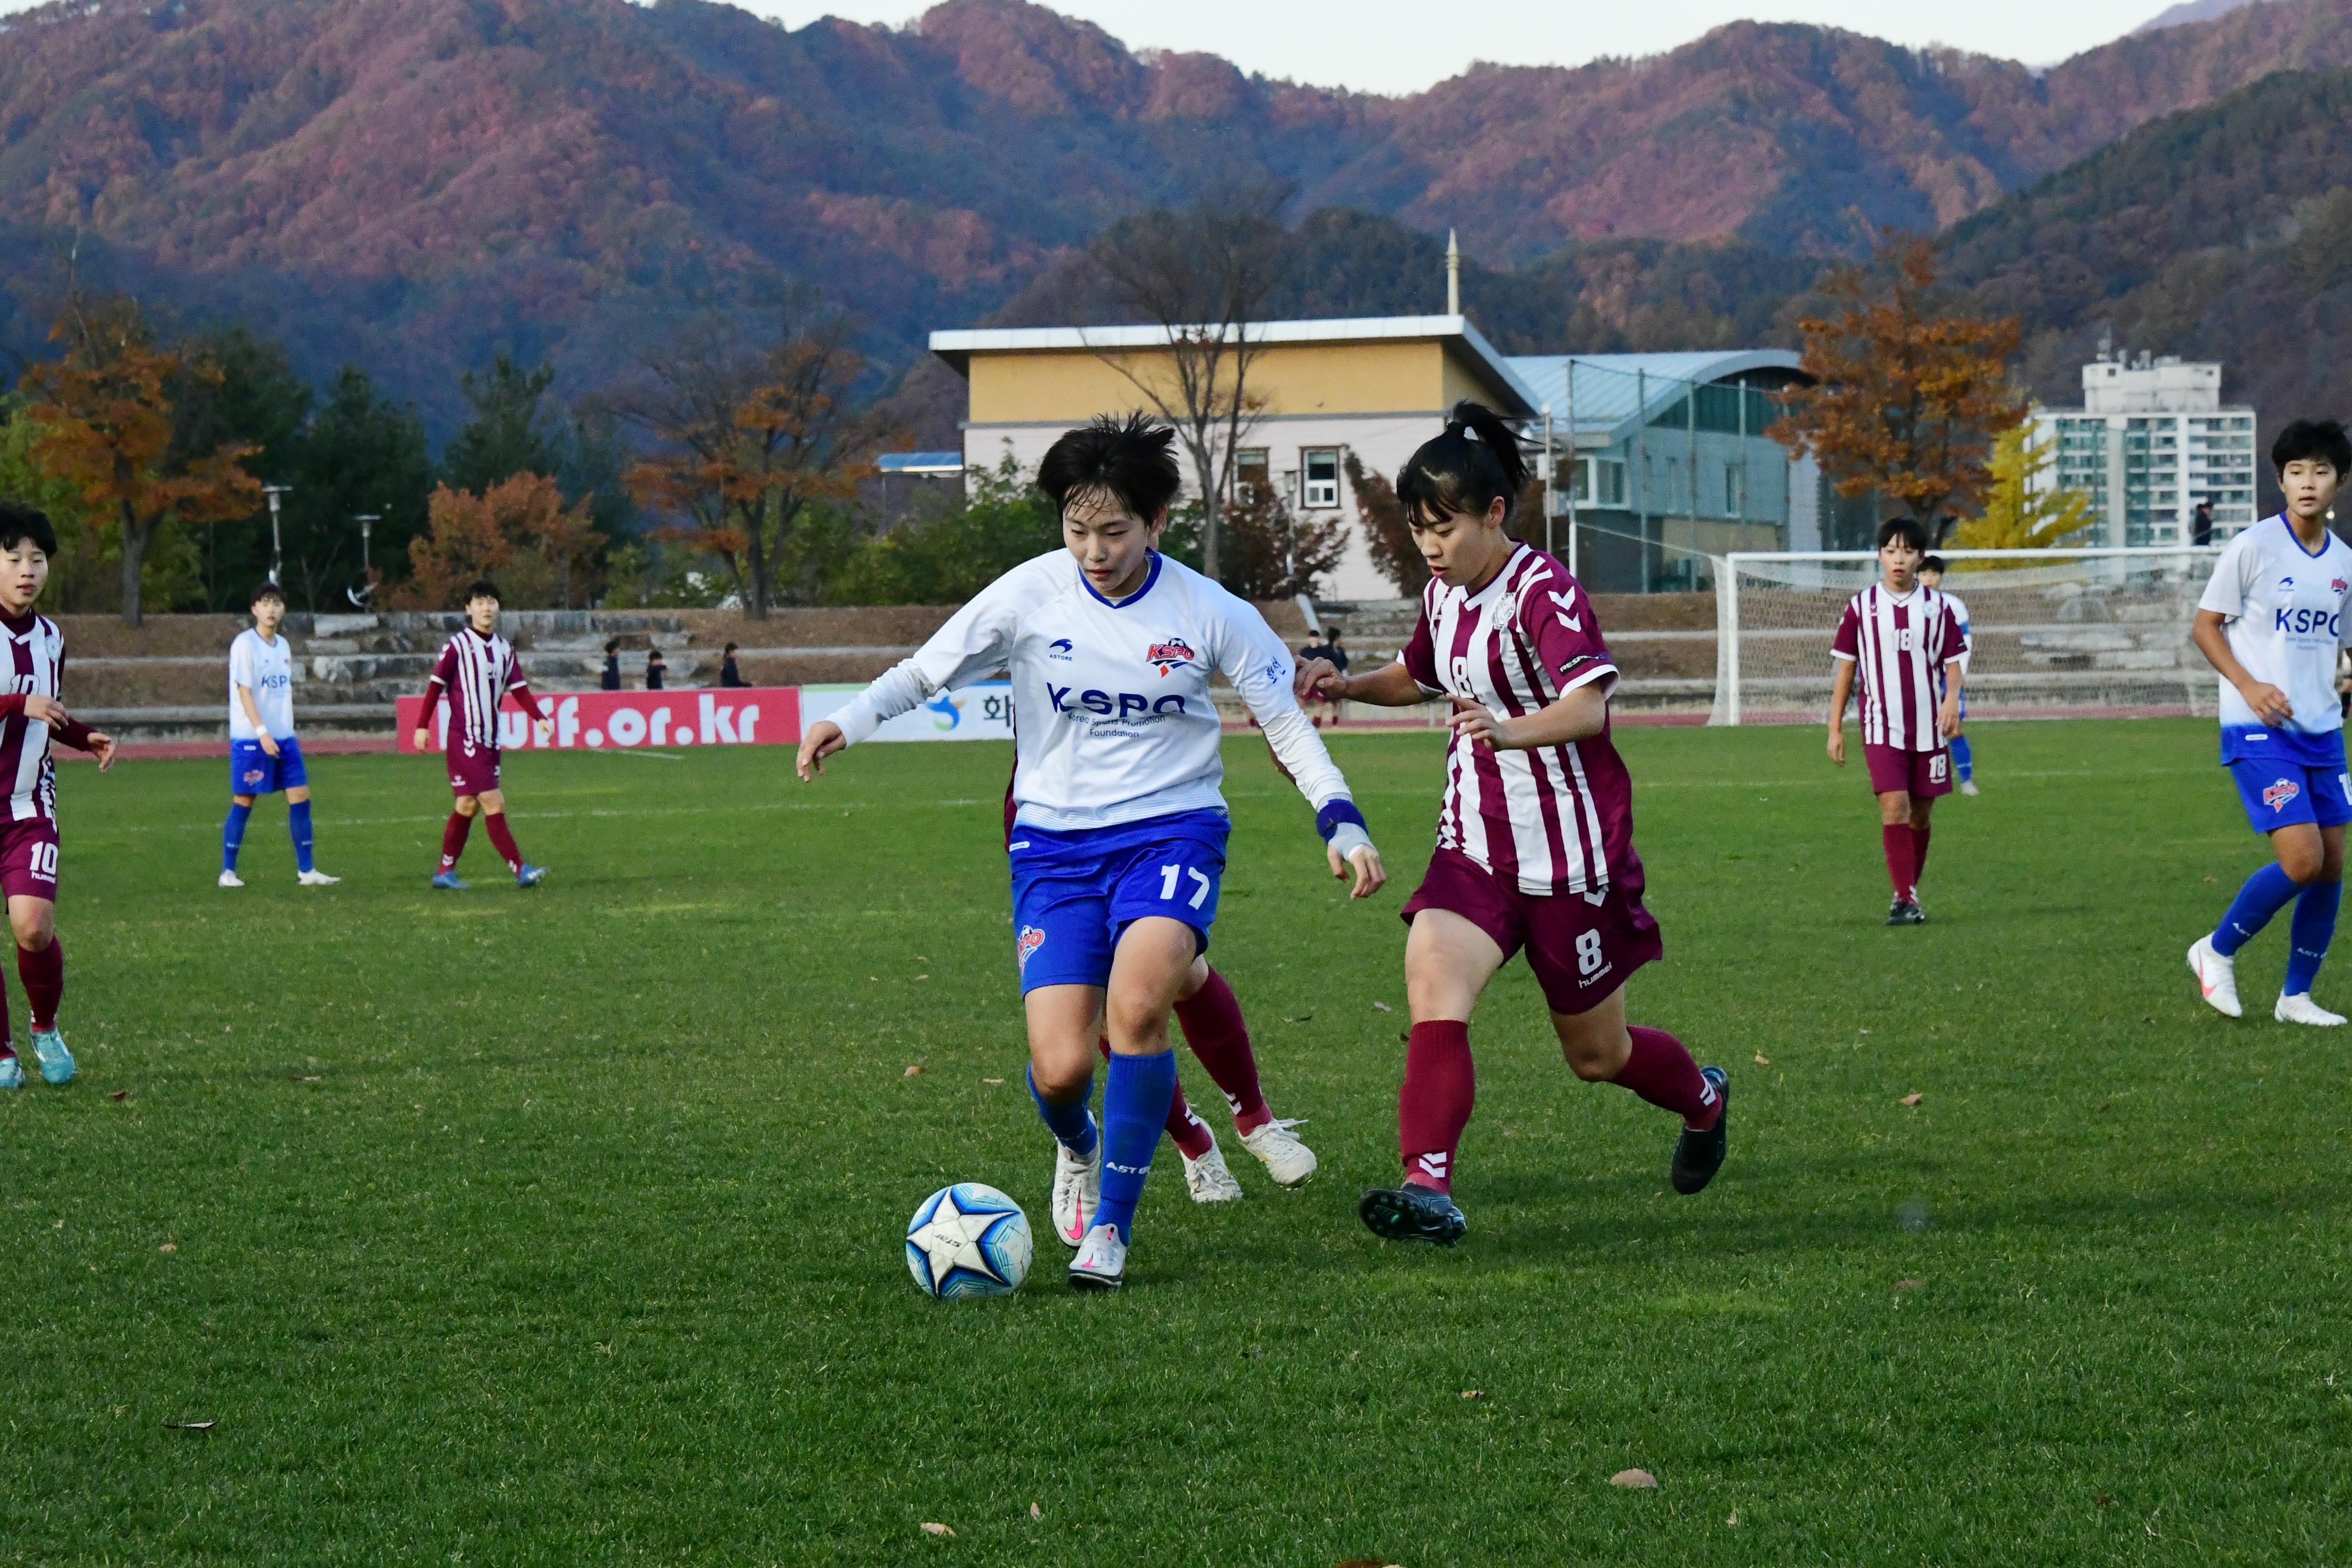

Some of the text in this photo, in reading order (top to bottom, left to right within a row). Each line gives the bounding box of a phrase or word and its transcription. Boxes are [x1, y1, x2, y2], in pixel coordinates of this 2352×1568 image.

[1892, 628, 1914, 651] 18
[1146, 644, 1195, 662] KSPO
[1560, 655, 1599, 672] RESP
[262, 675, 293, 689] KSP
[1452, 656, 1475, 699] 8
[1047, 682, 1186, 718] KSPO
[1067, 713, 1089, 723] Korea
[1090, 729, 1139, 738] Foundation
[1929, 754, 1946, 778] 18
[30, 841, 58, 875] 10
[1160, 864, 1210, 910] 17
[1576, 928, 1602, 975] 8
[1579, 961, 1612, 988] hummel
